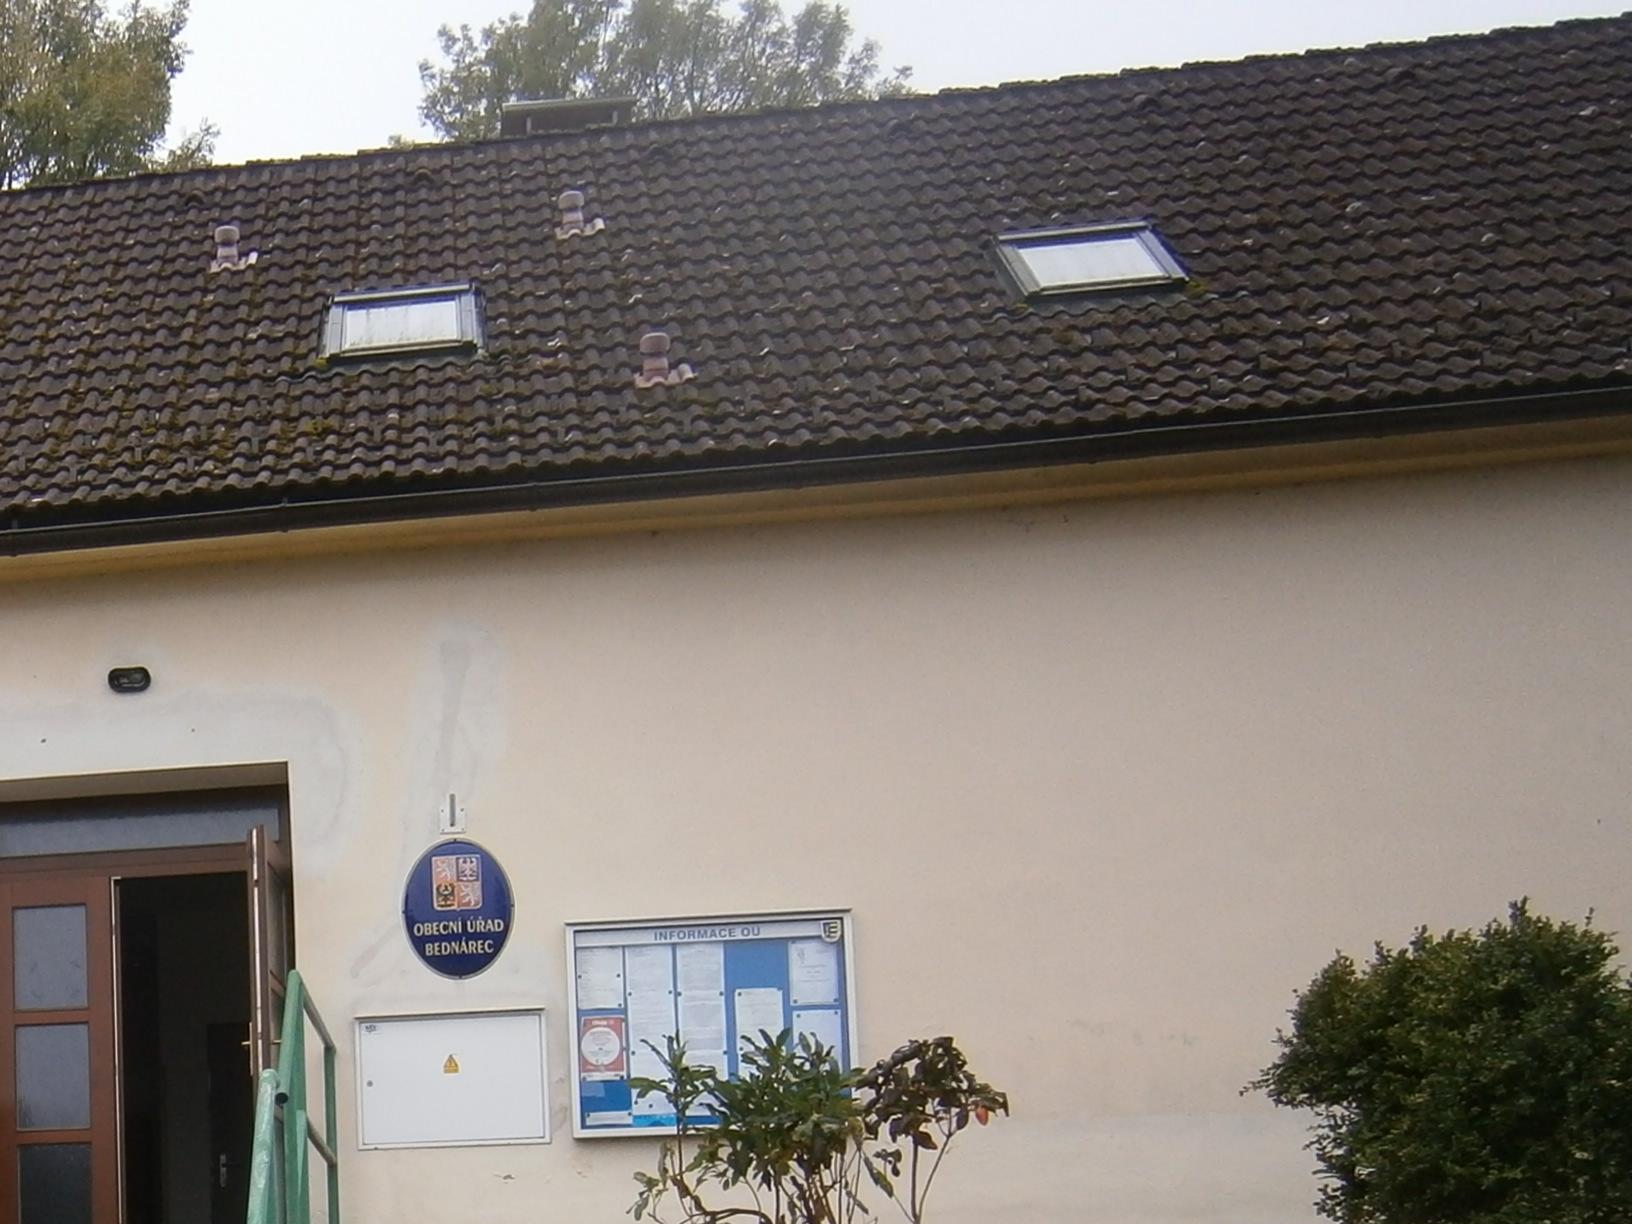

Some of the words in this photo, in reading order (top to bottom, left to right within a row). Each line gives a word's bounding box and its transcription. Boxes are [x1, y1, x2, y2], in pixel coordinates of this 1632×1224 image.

[413, 917, 462, 936] OBECNÍ
[467, 915, 504, 933] ÚŘAD
[654, 927, 737, 941] INFORMACE
[424, 936, 494, 956] BEDNÁREC
